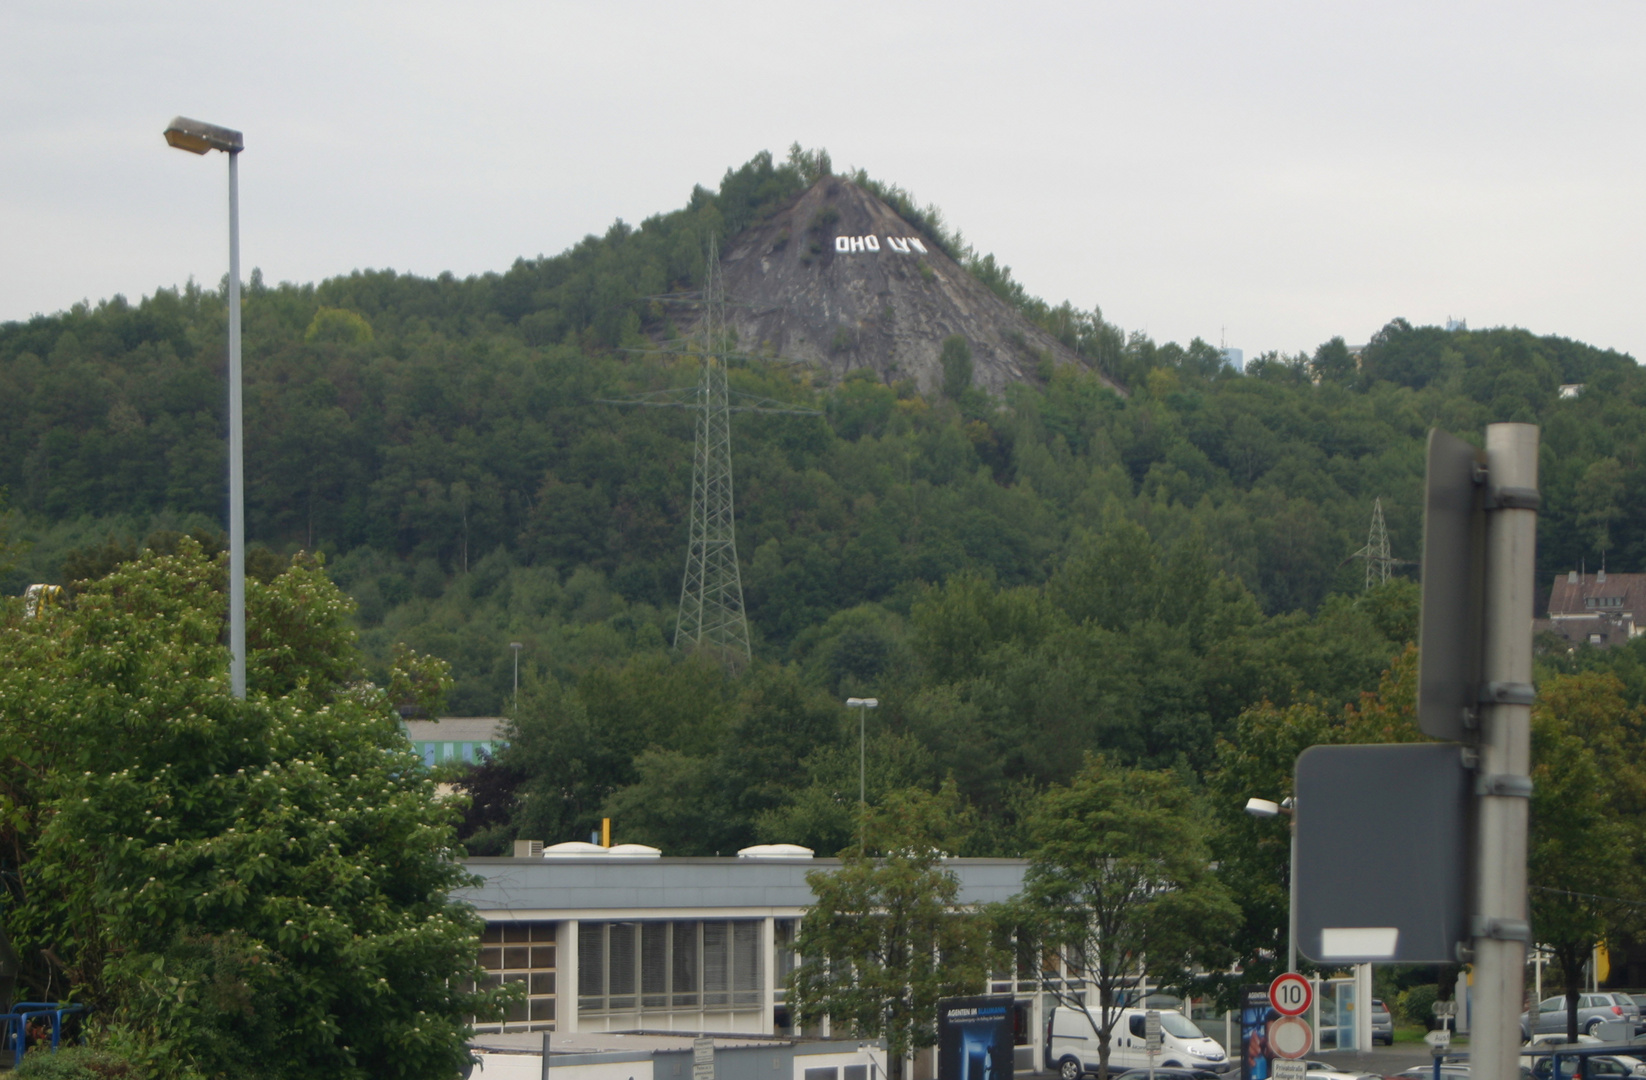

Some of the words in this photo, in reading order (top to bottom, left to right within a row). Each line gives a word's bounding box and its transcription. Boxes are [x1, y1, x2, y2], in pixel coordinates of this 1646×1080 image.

[1282, 985, 1301, 1004] 10
[947, 1008, 970, 1016] AGENTEN
[971, 1007, 978, 1015] IM
